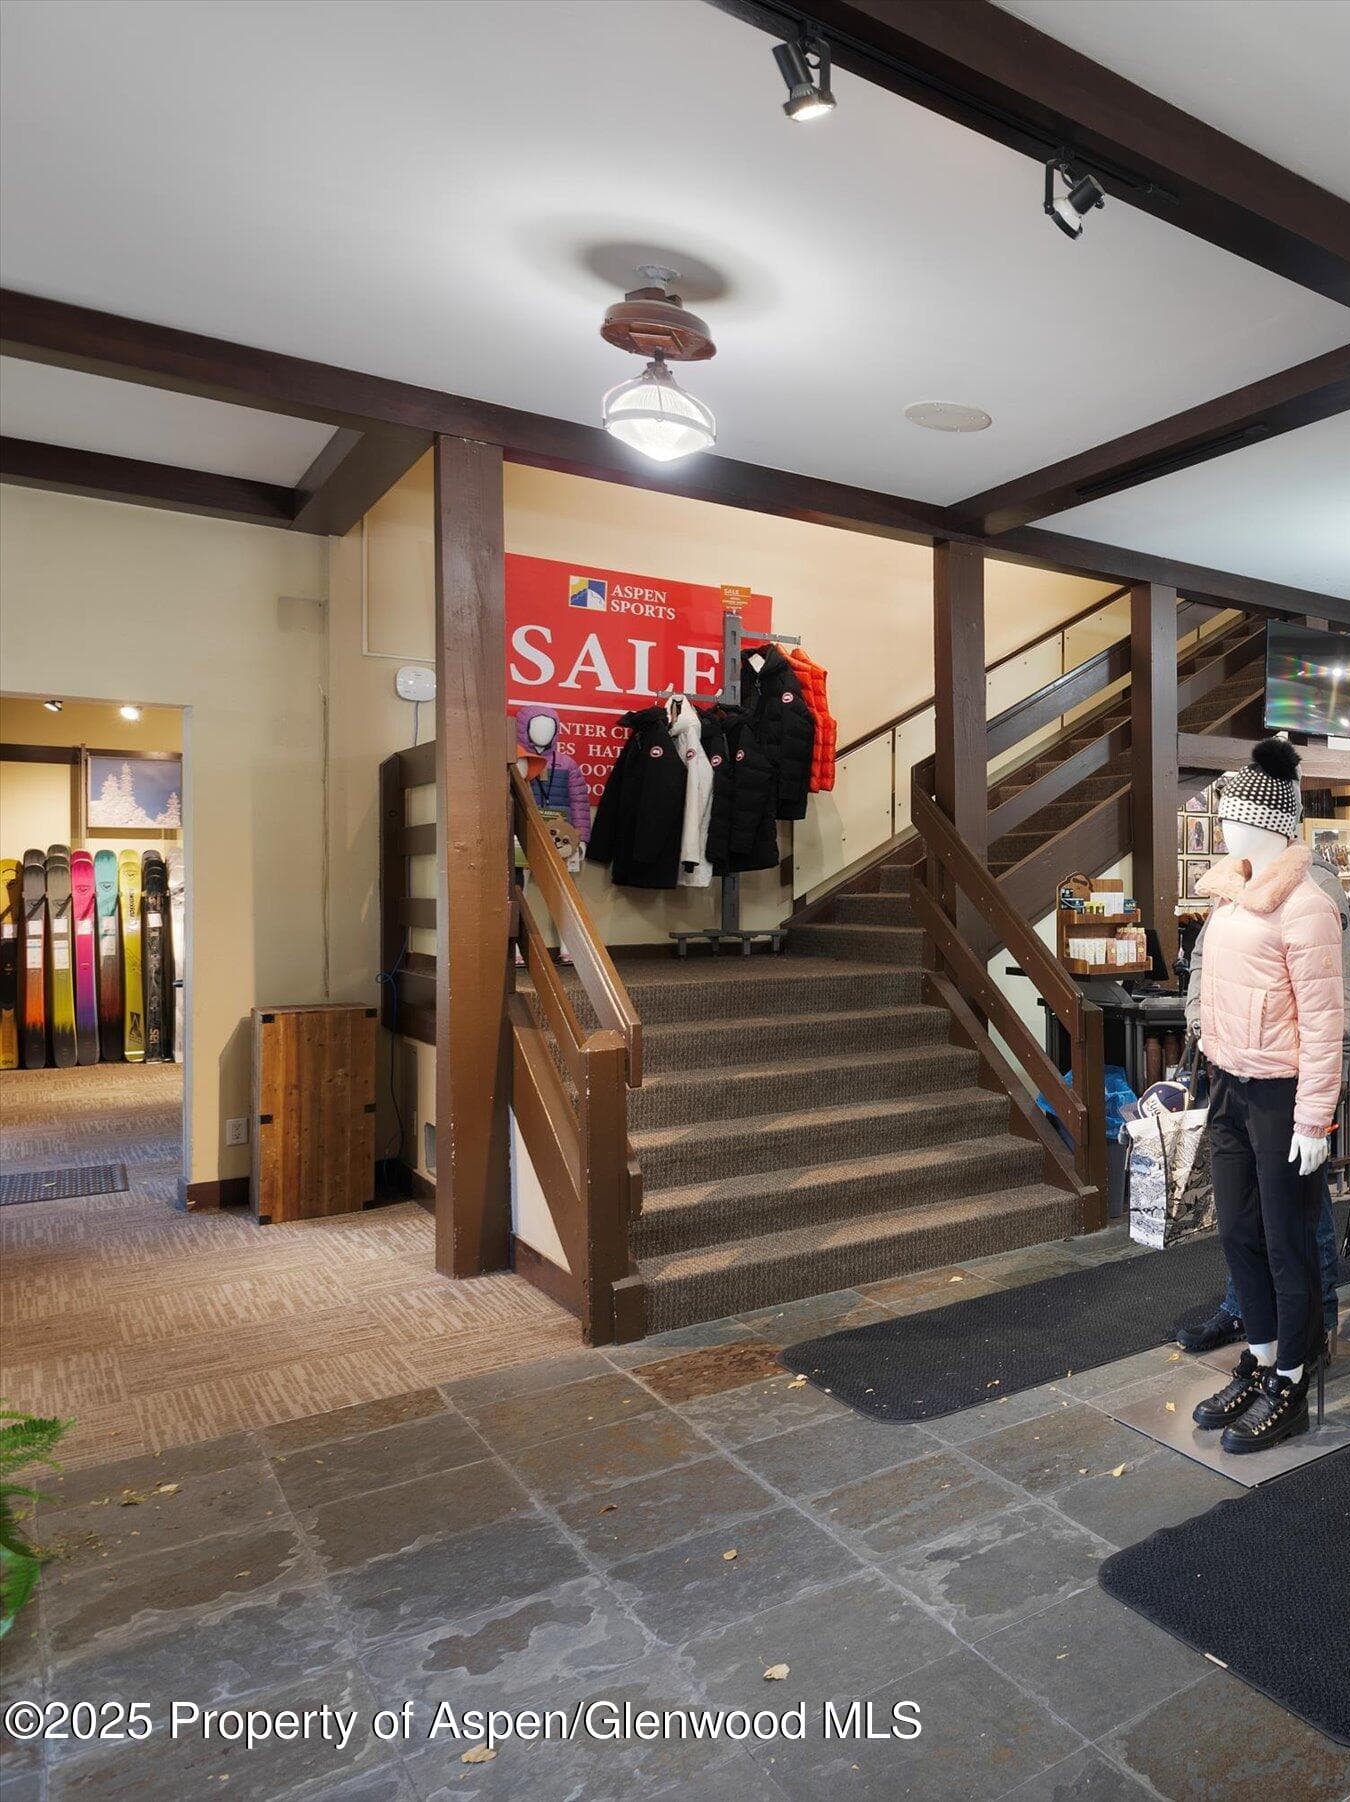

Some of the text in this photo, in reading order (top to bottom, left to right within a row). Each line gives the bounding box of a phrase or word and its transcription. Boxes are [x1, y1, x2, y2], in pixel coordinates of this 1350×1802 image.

[610, 584, 667, 603] ASPEN
[610, 599, 676, 620] SPORTS
[509, 624, 724, 698] SALE
[558, 722, 607, 738] NTER
[556, 741, 624, 758] ES HAT
